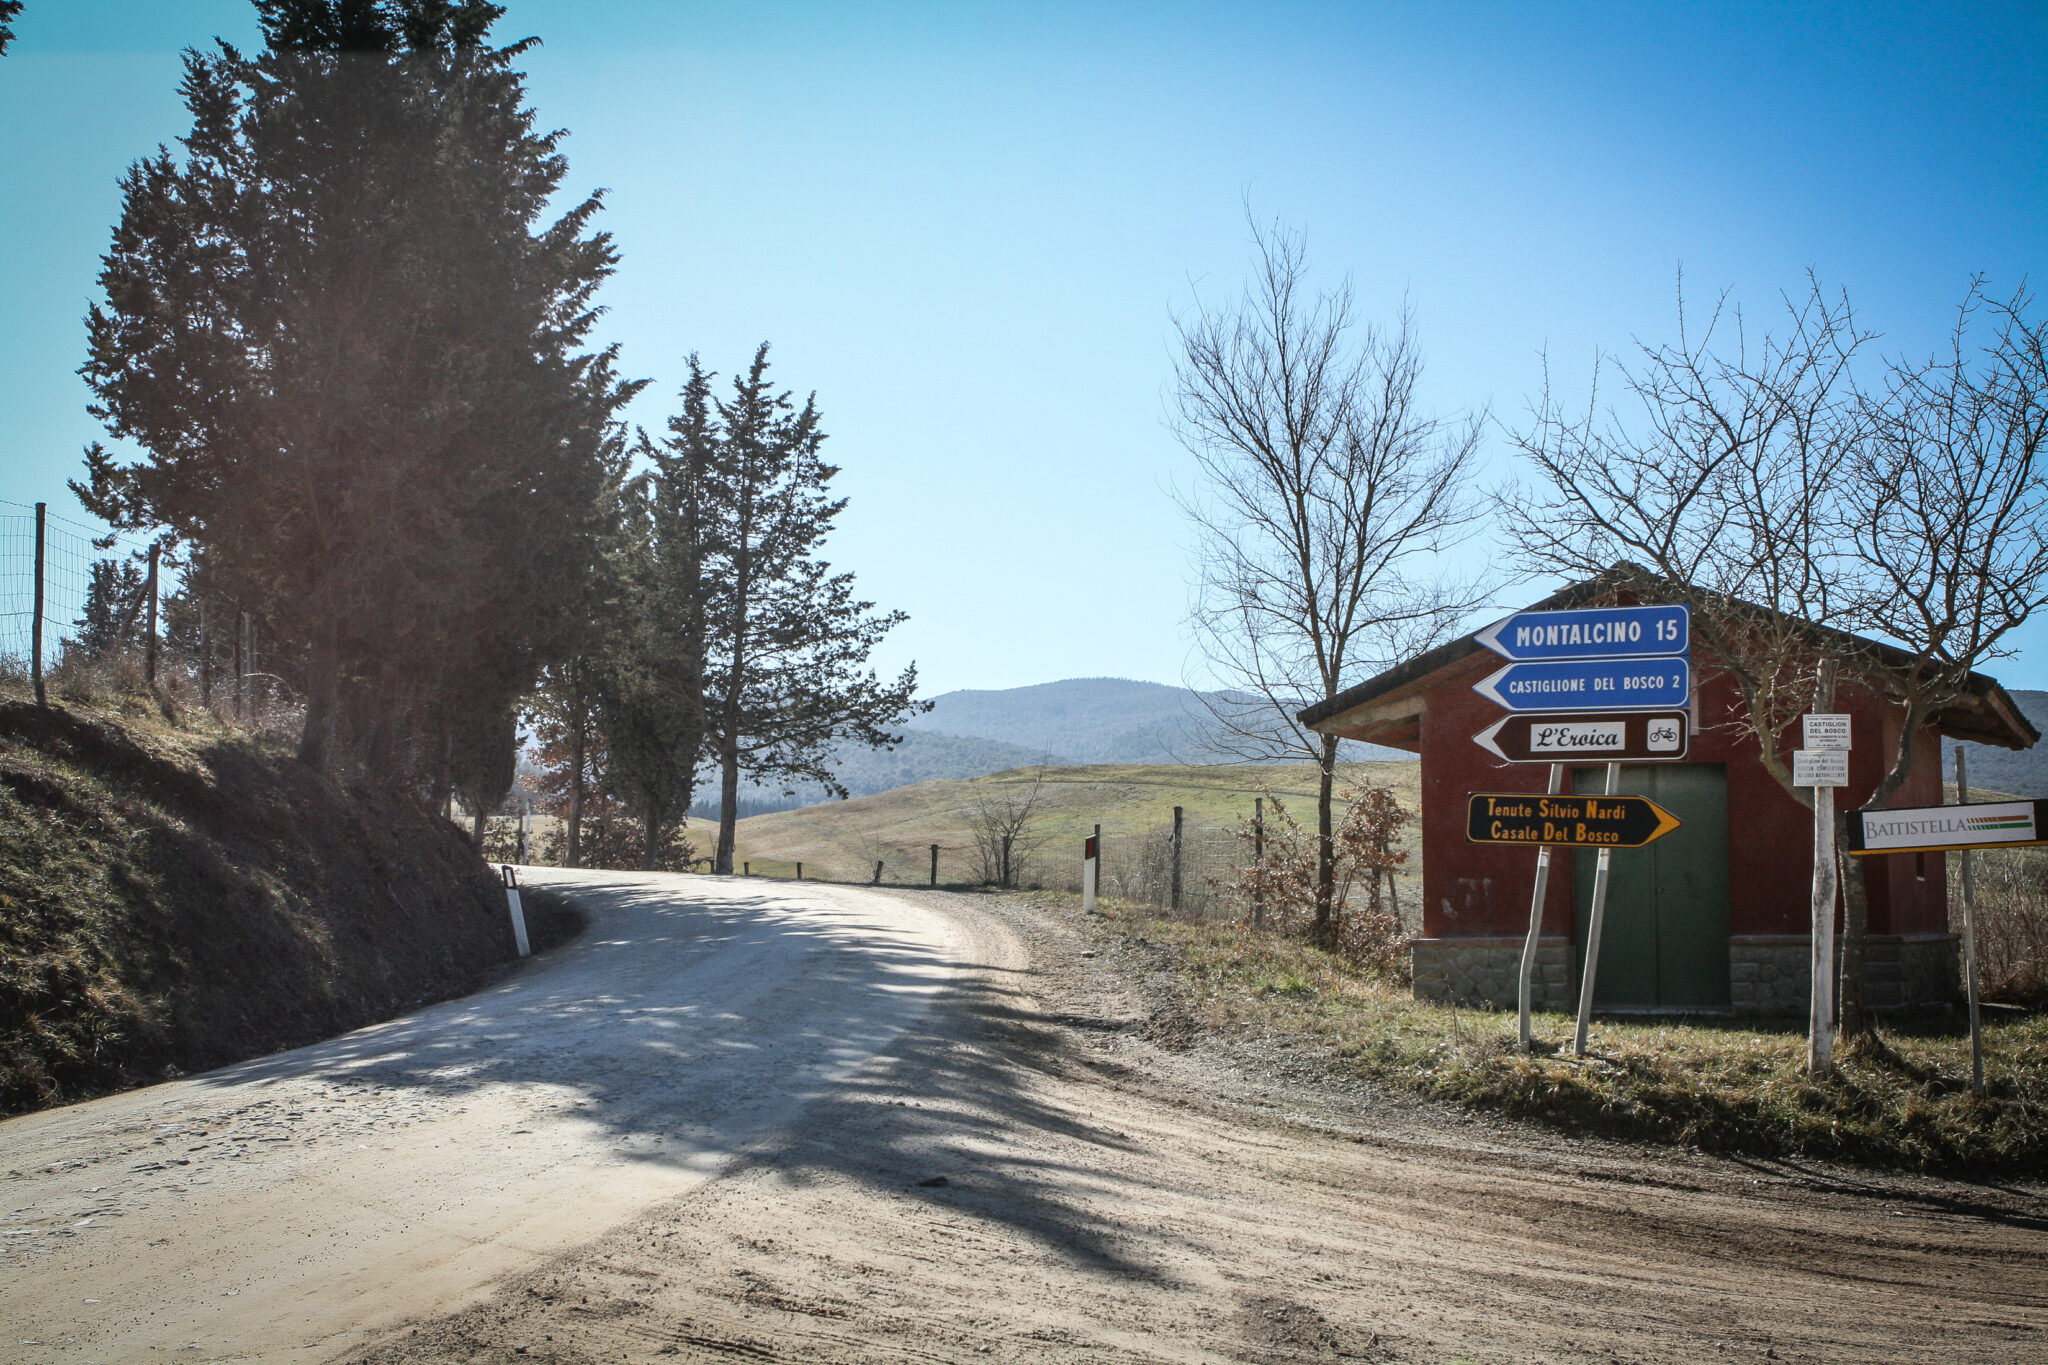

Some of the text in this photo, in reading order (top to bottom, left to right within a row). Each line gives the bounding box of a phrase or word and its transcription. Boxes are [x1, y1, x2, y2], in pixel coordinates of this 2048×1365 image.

[1516, 619, 1678, 647] MONTALCINO 15
[1509, 675, 1680, 693] CASTIGLIONE DEL BOSCO 2
[1537, 727, 1619, 747] L'Eroica
[1488, 798, 1625, 820] Tenute Silvio Nardi
[1491, 820, 1619, 842] Casale Del Bosco
[1865, 819, 1966, 839] BATTISTELLA
